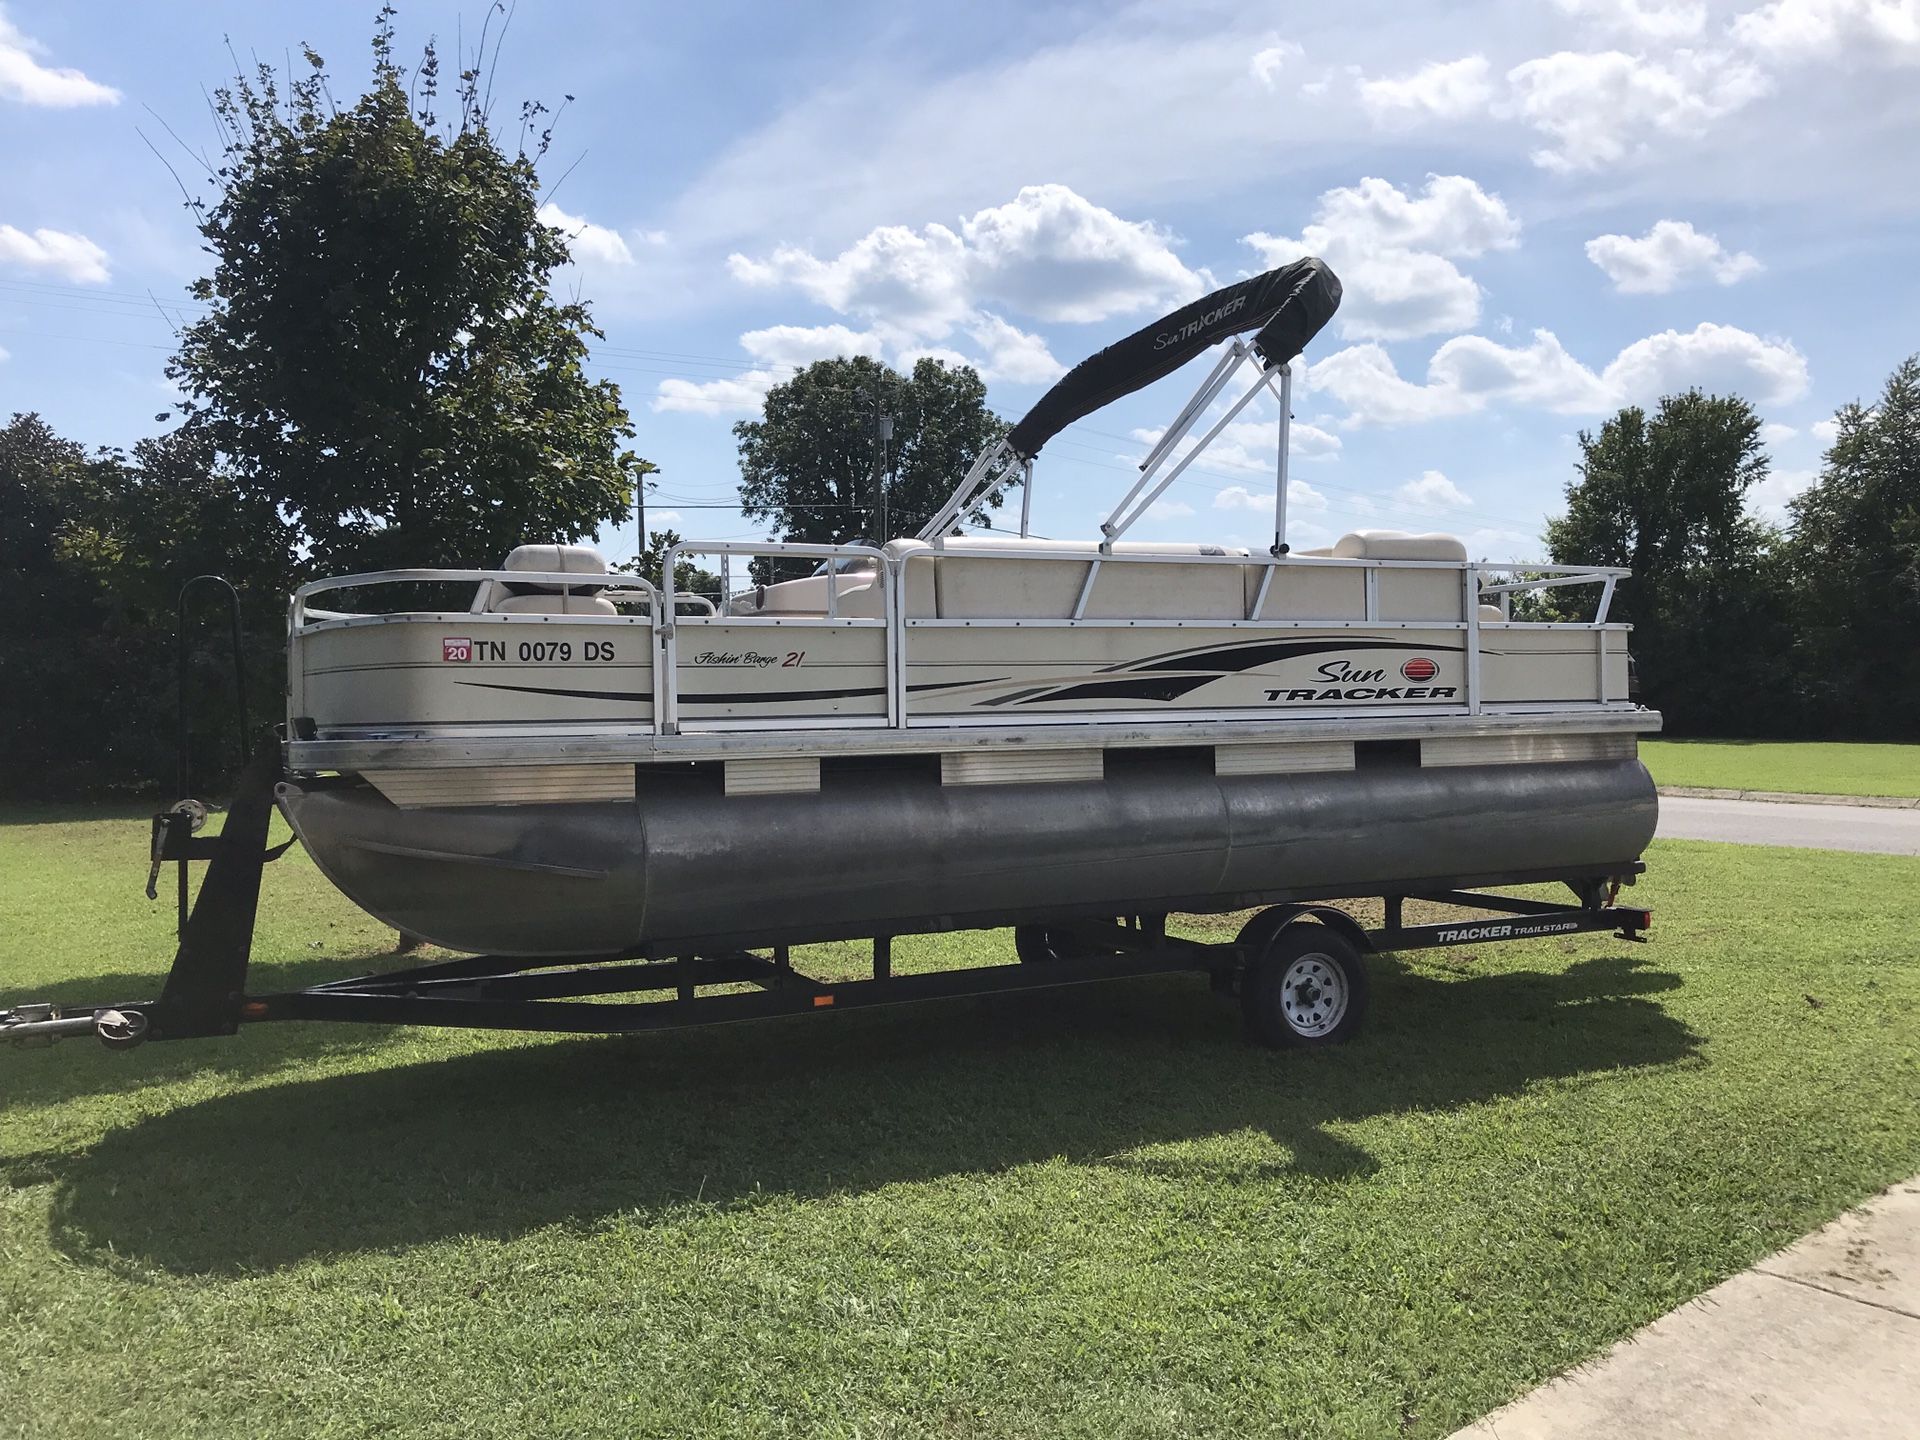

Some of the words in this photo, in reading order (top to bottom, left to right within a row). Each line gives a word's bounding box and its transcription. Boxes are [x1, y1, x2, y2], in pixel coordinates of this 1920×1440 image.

[1179, 295, 1247, 341] TRACKER
[474, 640, 506, 661] TN
[518, 641, 572, 662] 0079
[584, 641, 615, 662] DS
[743, 651, 778, 668] Barge
[781, 651, 806, 668] 21
[1308, 660, 1387, 684] Sun
[1263, 686, 1458, 702] TRACKER
[1437, 925, 1513, 943] TRACKER
[1514, 922, 1571, 935] TRAILSTAR
